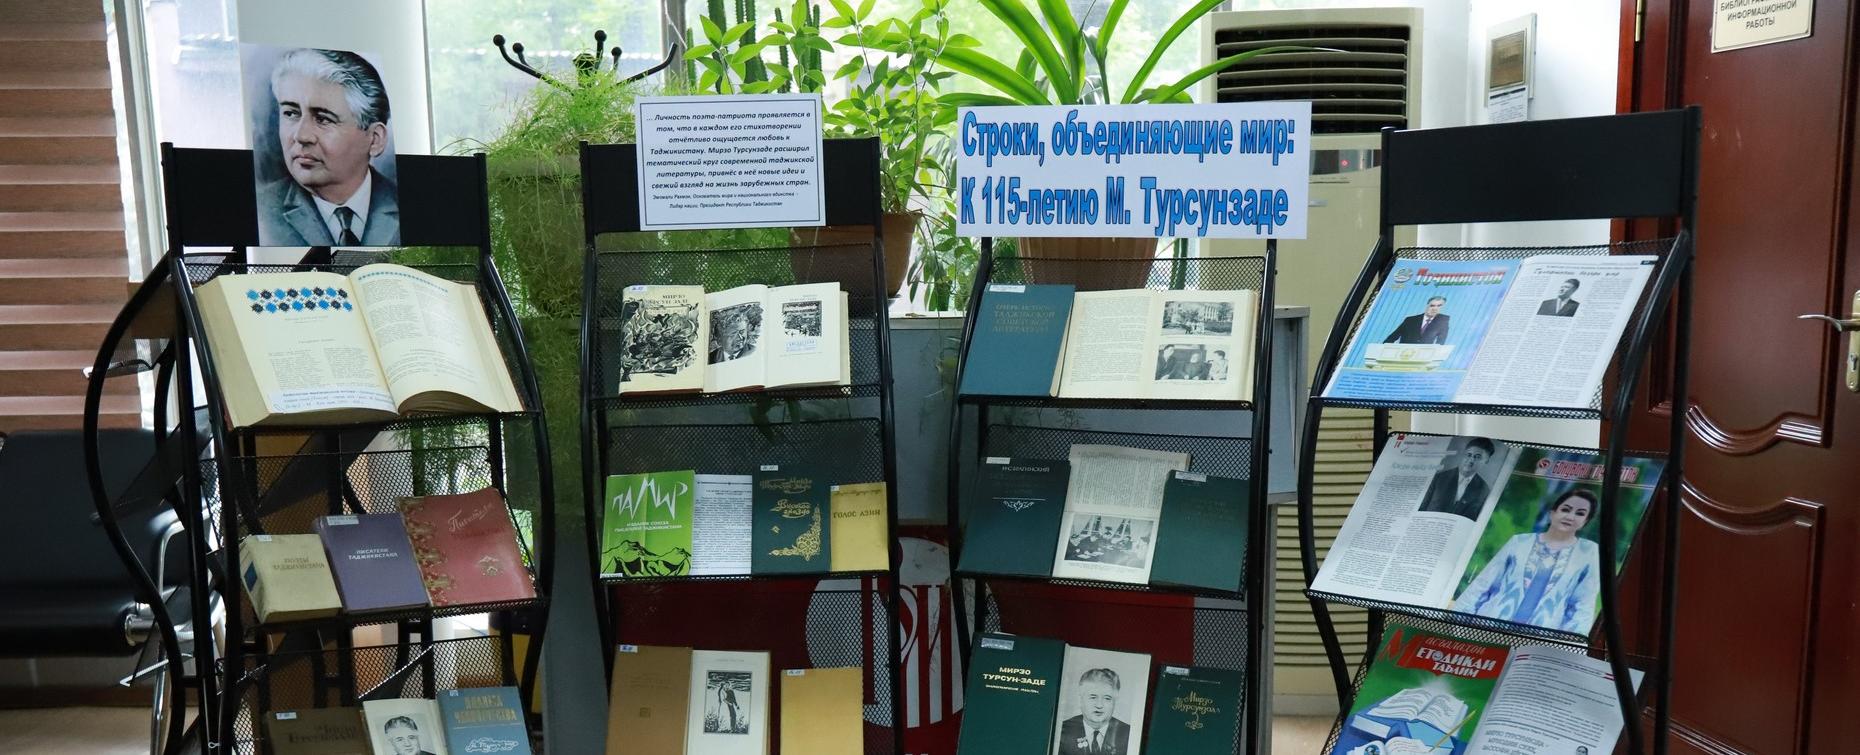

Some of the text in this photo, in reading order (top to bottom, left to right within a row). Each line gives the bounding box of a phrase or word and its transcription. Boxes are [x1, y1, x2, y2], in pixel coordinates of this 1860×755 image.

[1728, 0, 1797, 21] ИНФОРМАЦИОННОЙ
[1746, 17, 1775, 29] РАБОТЫ
[962, 109, 1295, 166] Строки, объединяющие мир:
[961, 176, 1288, 236] К 115-летию М. Турсунзаде
[983, 673, 1046, 686] ТУРСУН-ЗАДЕ
[999, 667, 1031, 675] МИРЗО
